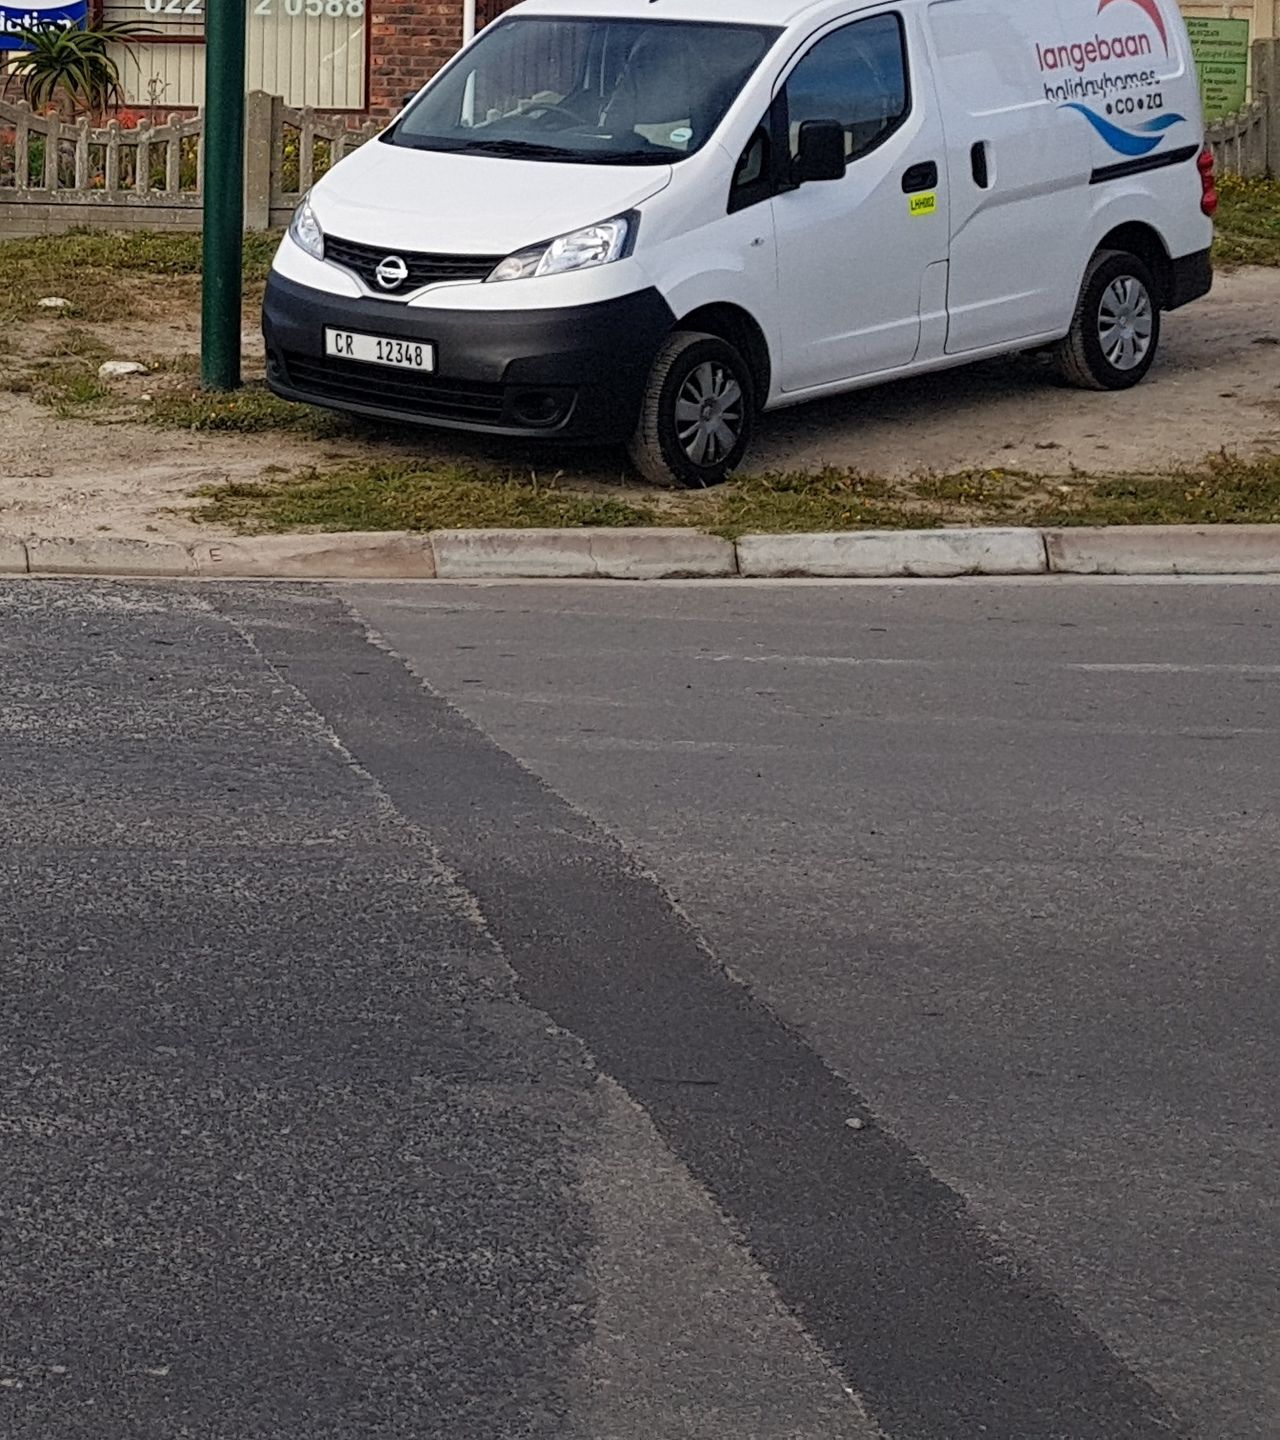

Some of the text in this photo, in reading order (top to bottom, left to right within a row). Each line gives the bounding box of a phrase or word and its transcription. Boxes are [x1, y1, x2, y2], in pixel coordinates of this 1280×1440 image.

[1036, 33, 1152, 72] langebaan
[1043, 70, 1161, 103] holidayhomes
[335, 333, 423, 366] CR 12348
